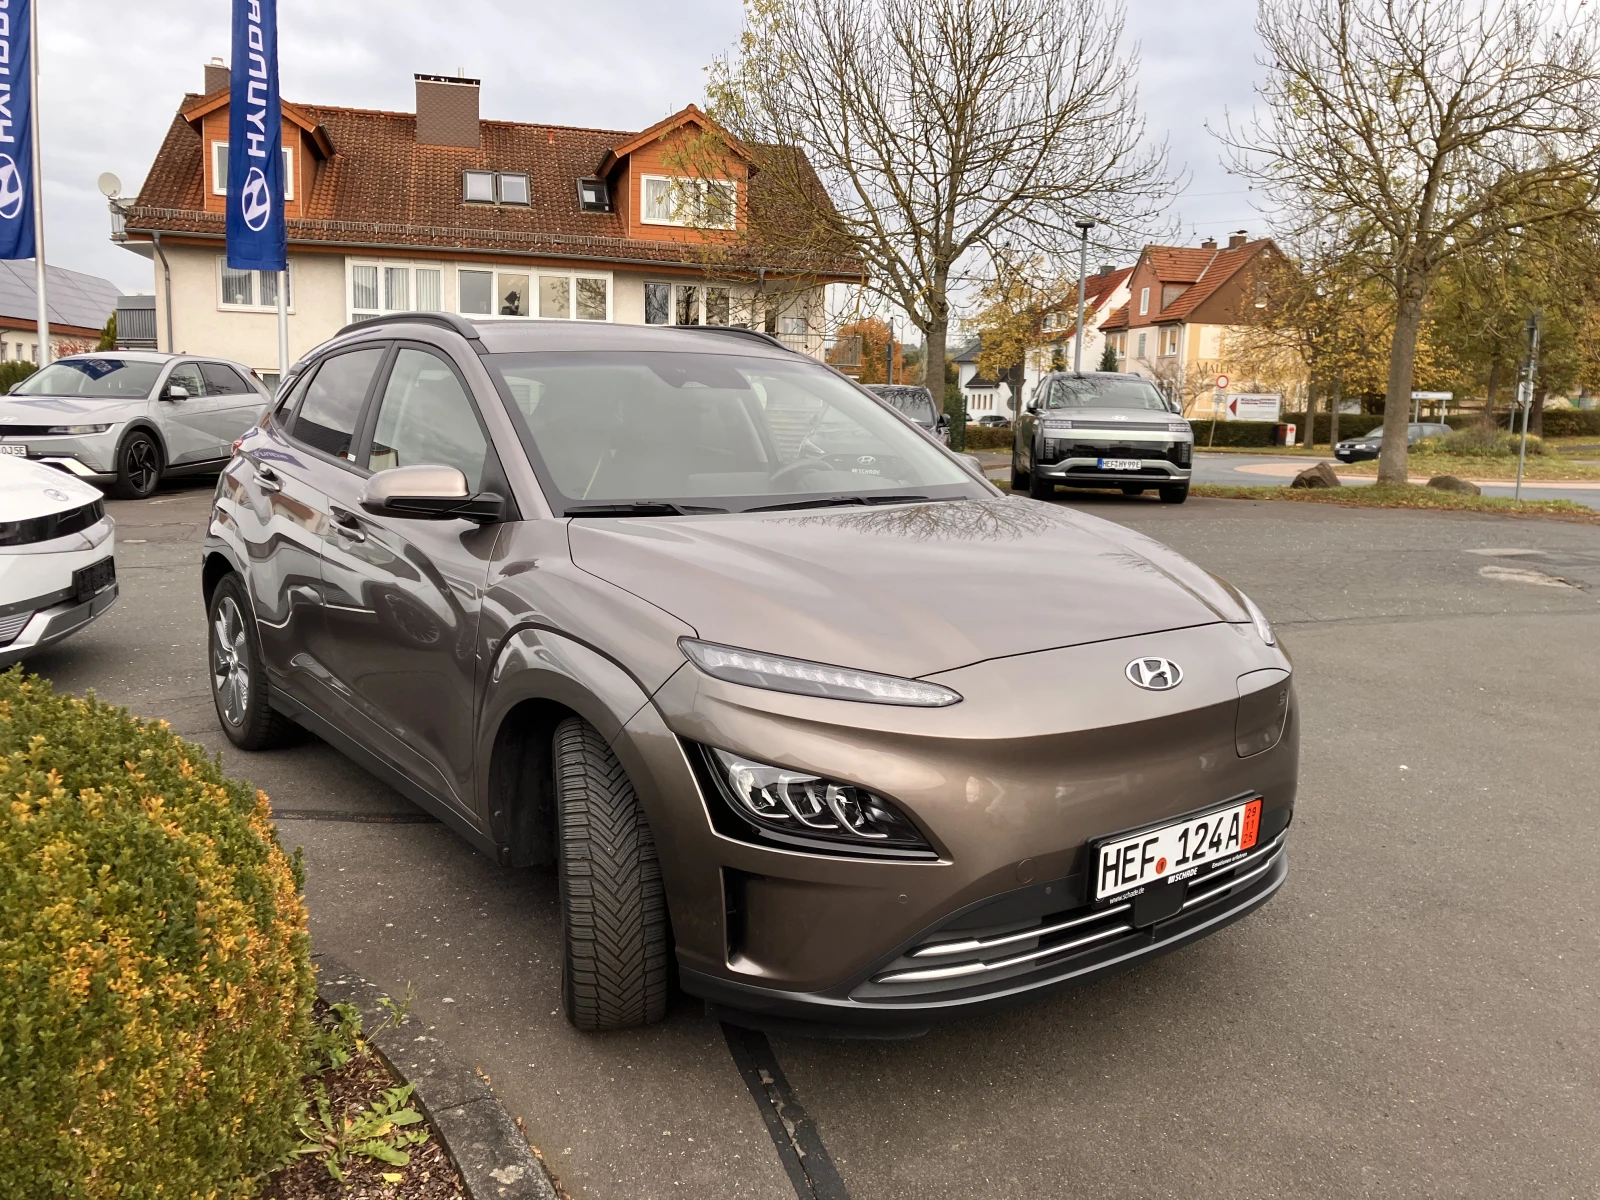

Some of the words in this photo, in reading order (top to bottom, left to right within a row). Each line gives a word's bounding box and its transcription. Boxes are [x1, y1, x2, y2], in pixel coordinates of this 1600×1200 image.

[1246, 806, 1257, 819] 29
[1245, 819, 1255, 831] 11
[1243, 832, 1253, 844] 25
[1101, 837, 1160, 892] HEF
[1175, 811, 1240, 867] 124A
[1109, 887, 1145, 904] www.schade.de
[1174, 867, 1199, 883] SCHADE
